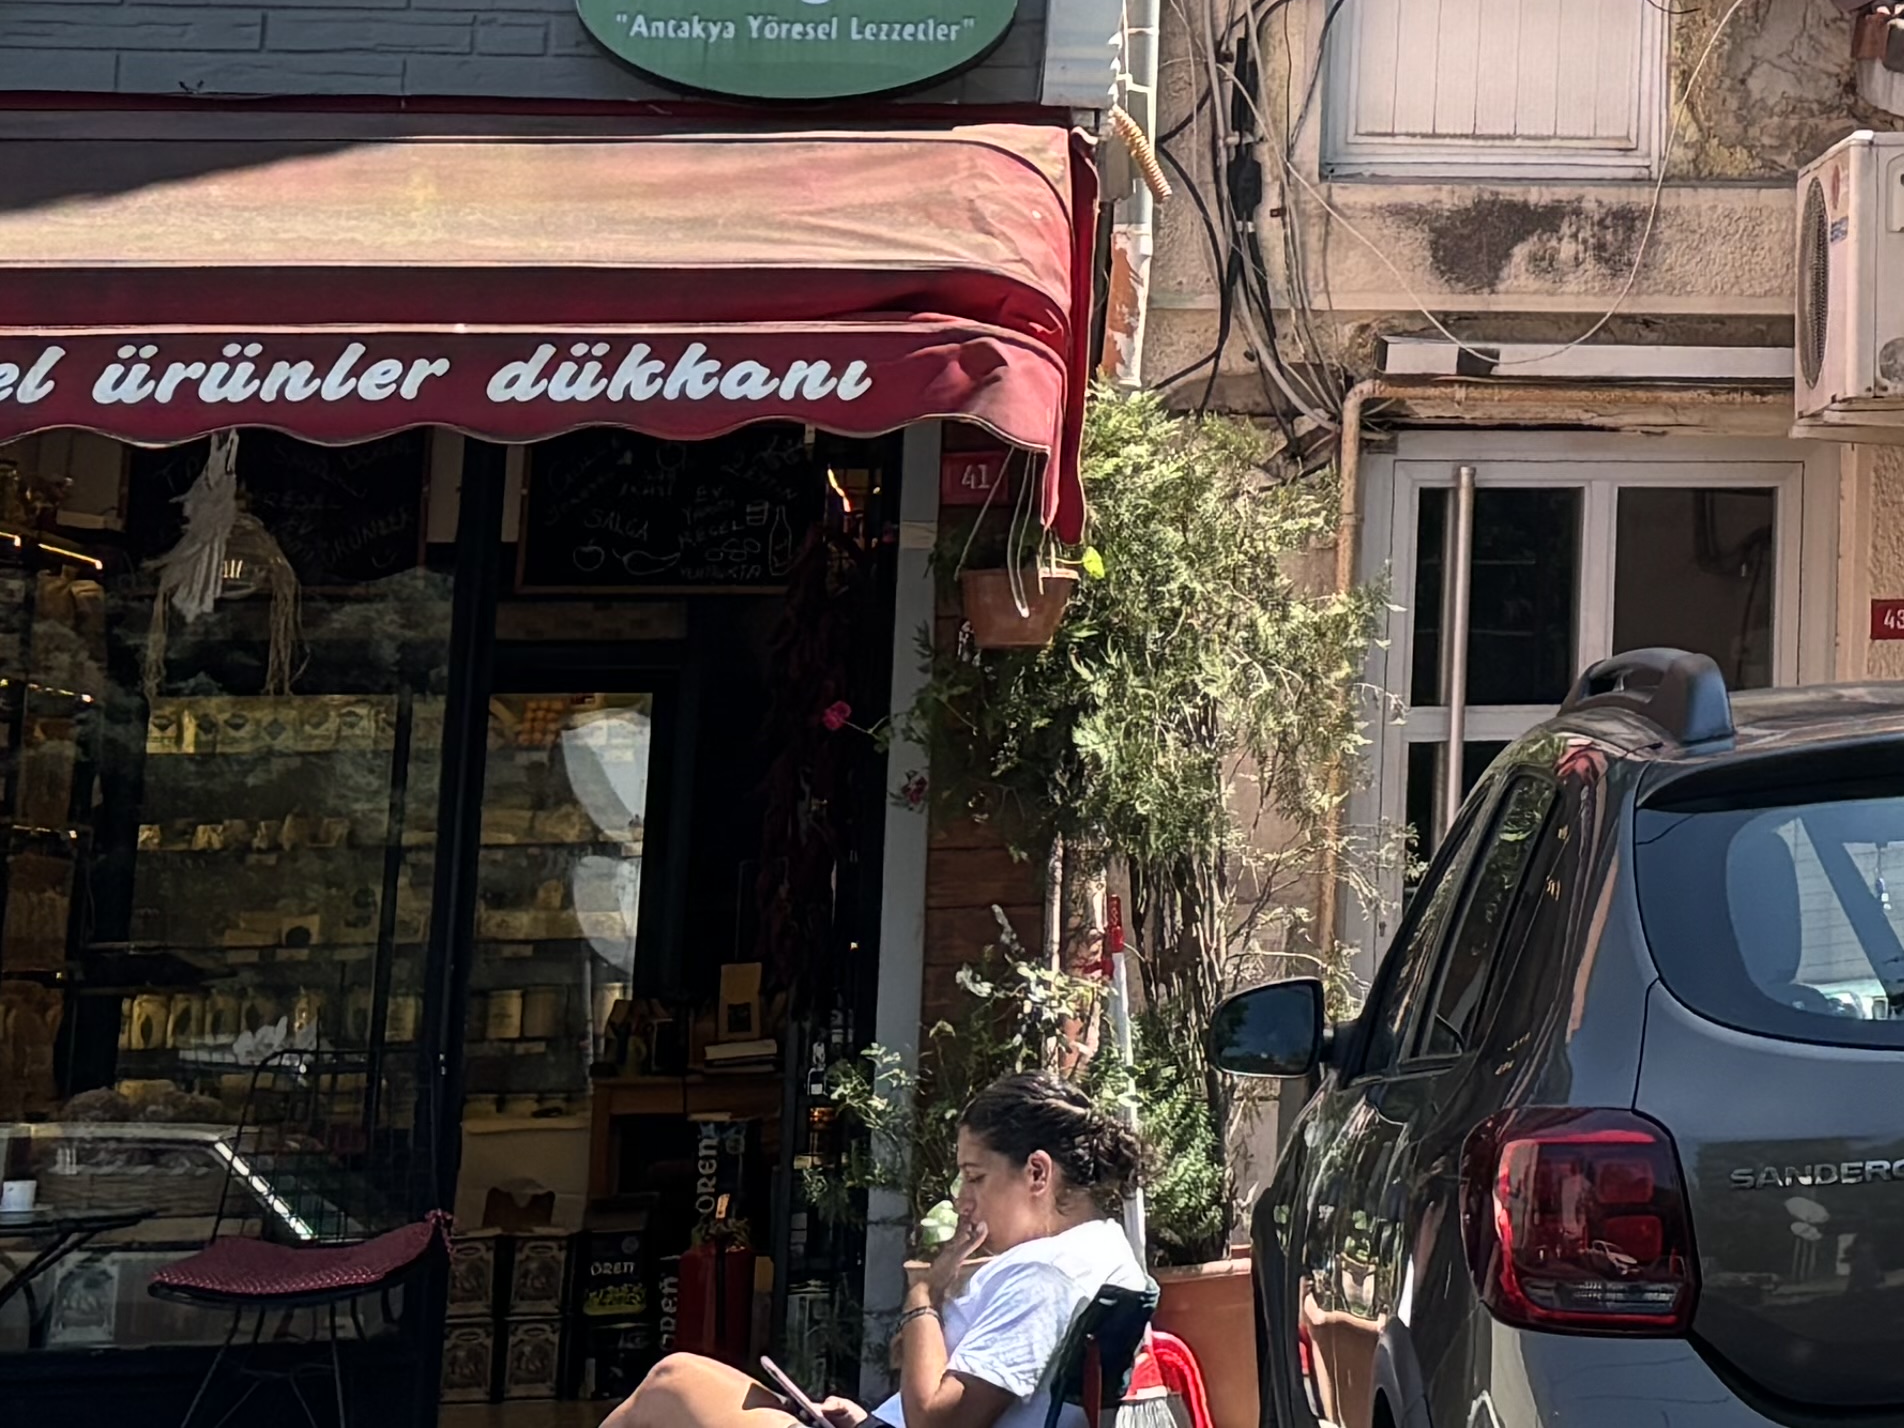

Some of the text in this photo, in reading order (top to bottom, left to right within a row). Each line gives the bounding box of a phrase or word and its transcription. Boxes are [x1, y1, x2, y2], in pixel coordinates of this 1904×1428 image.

[747, 15, 837, 41] Yöresel
[92, 343, 449, 404] ürünler
[486, 343, 873, 404] dükkanı
